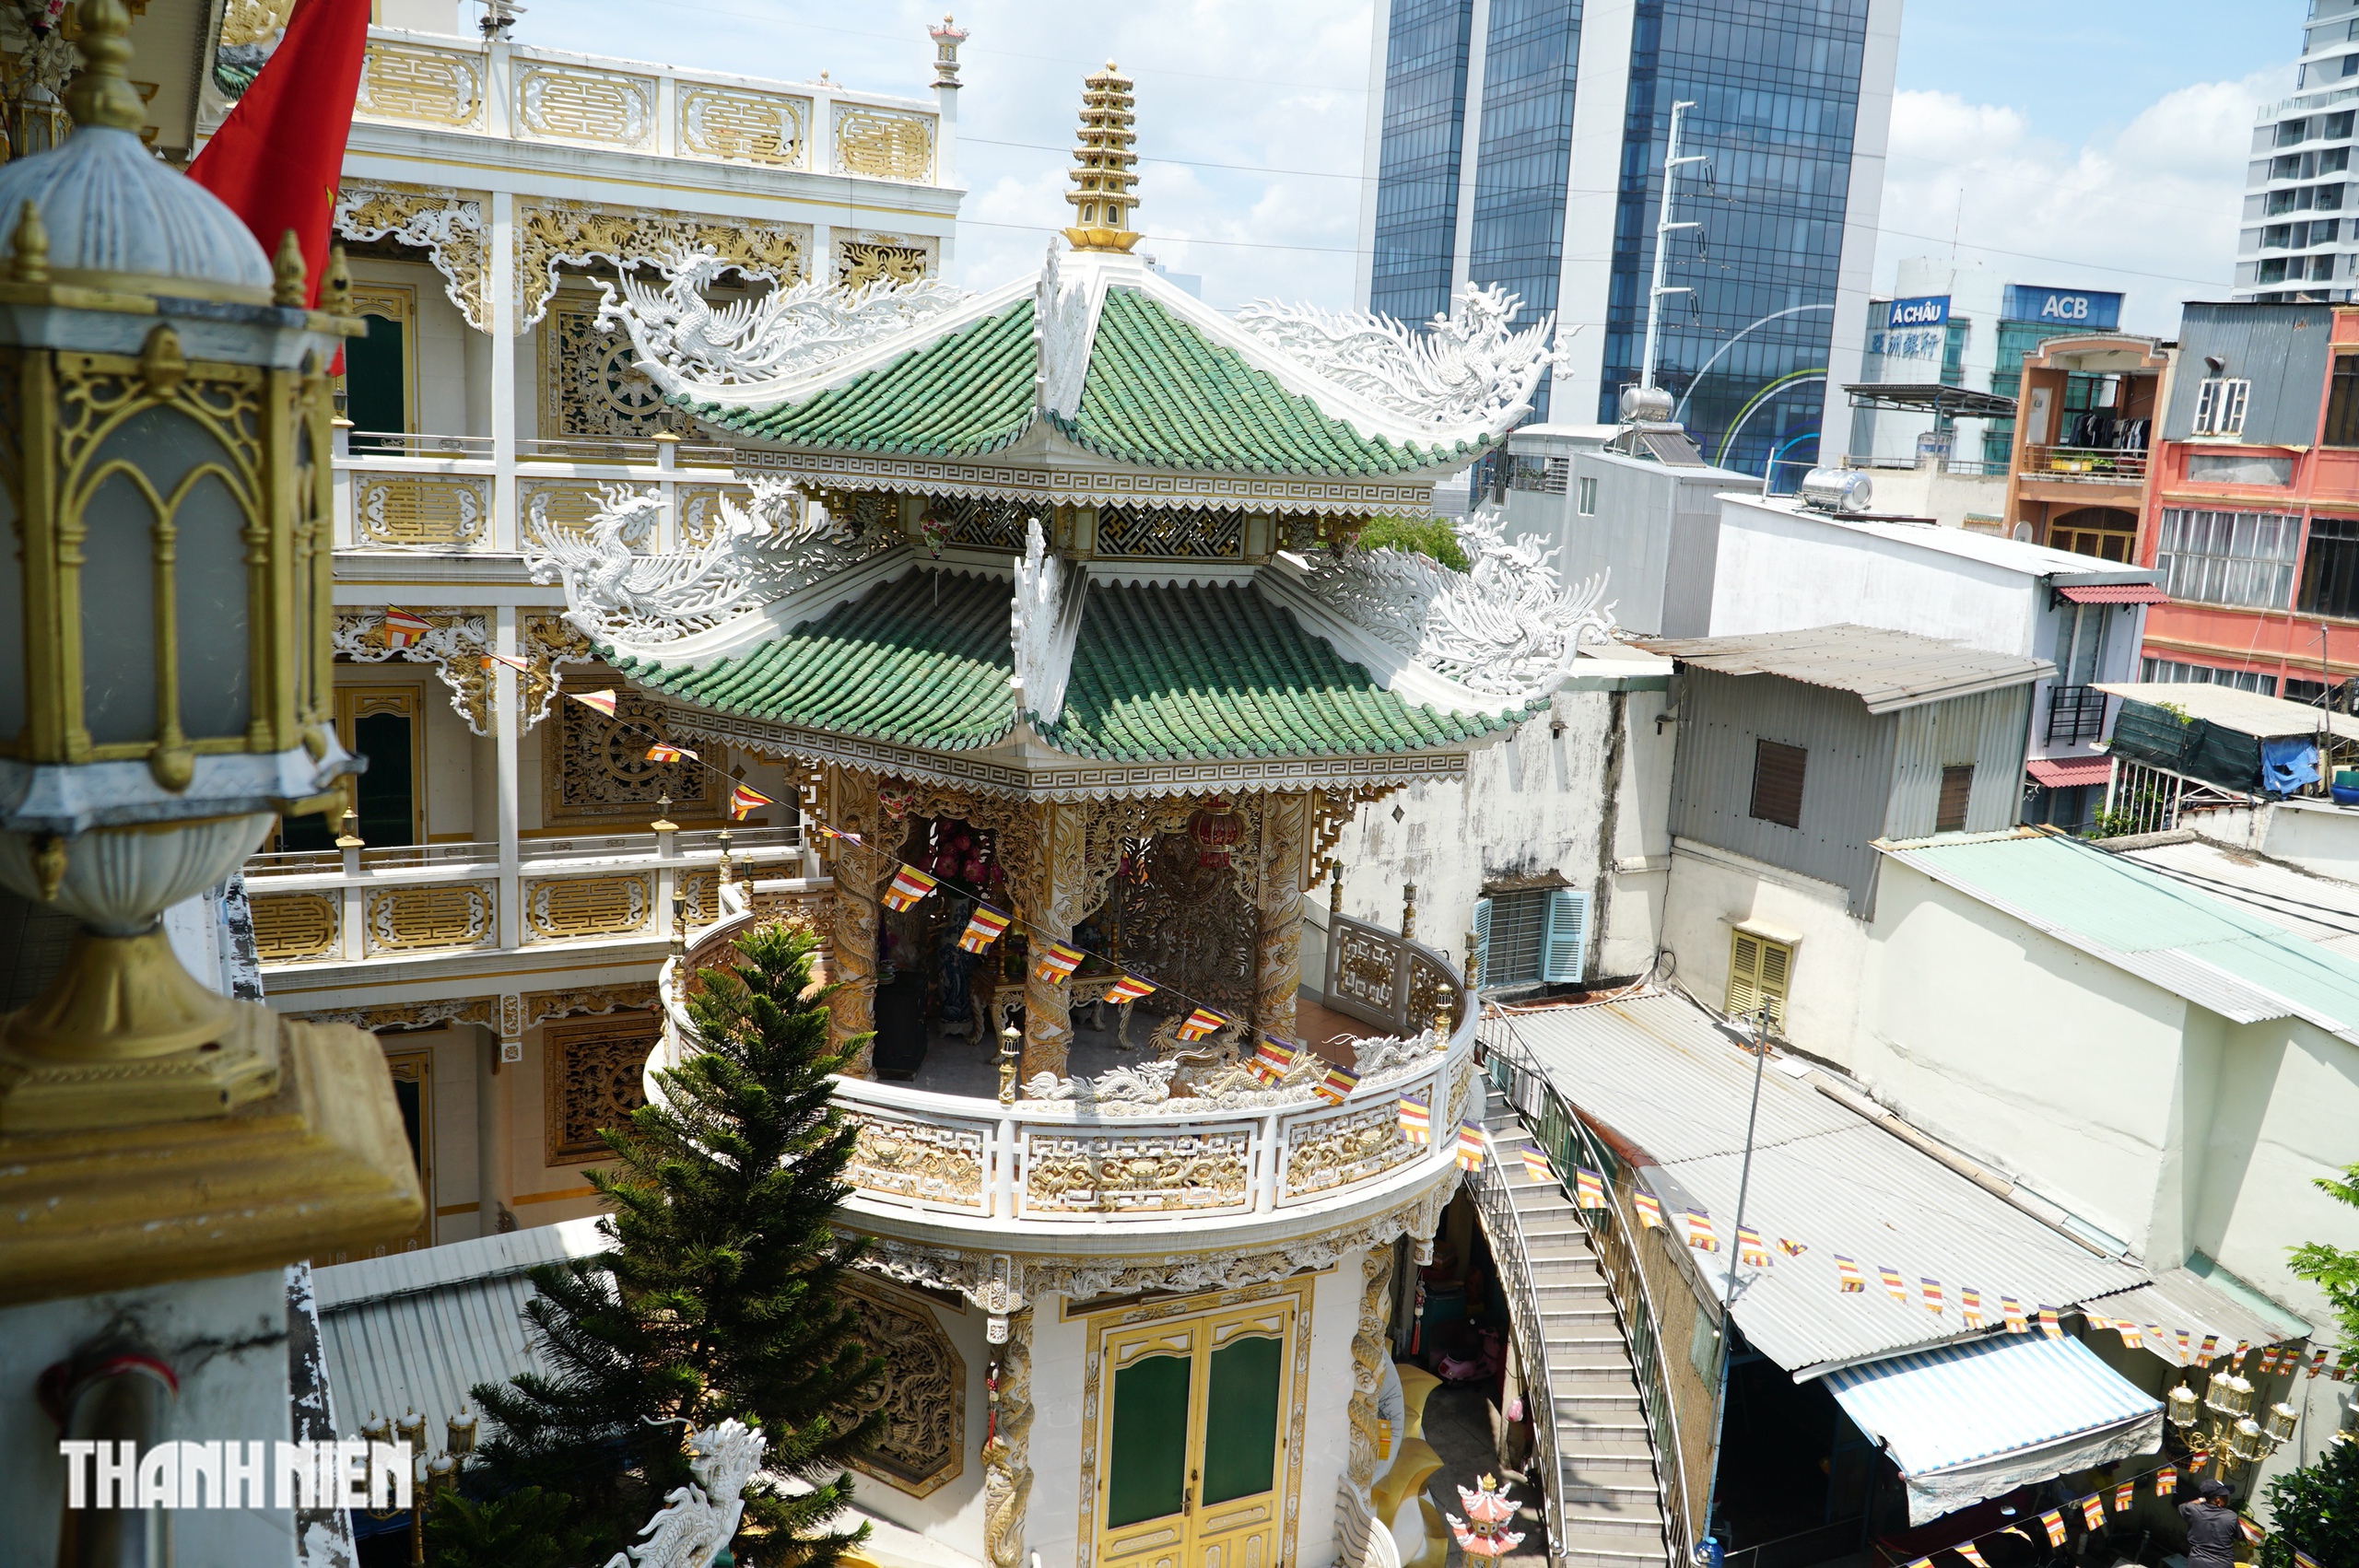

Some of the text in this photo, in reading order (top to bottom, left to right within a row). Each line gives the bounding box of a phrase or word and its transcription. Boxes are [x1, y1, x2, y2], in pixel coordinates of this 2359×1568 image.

[1892, 300, 1942, 324] Á CHÂU
[2041, 295, 2088, 319] ACB
